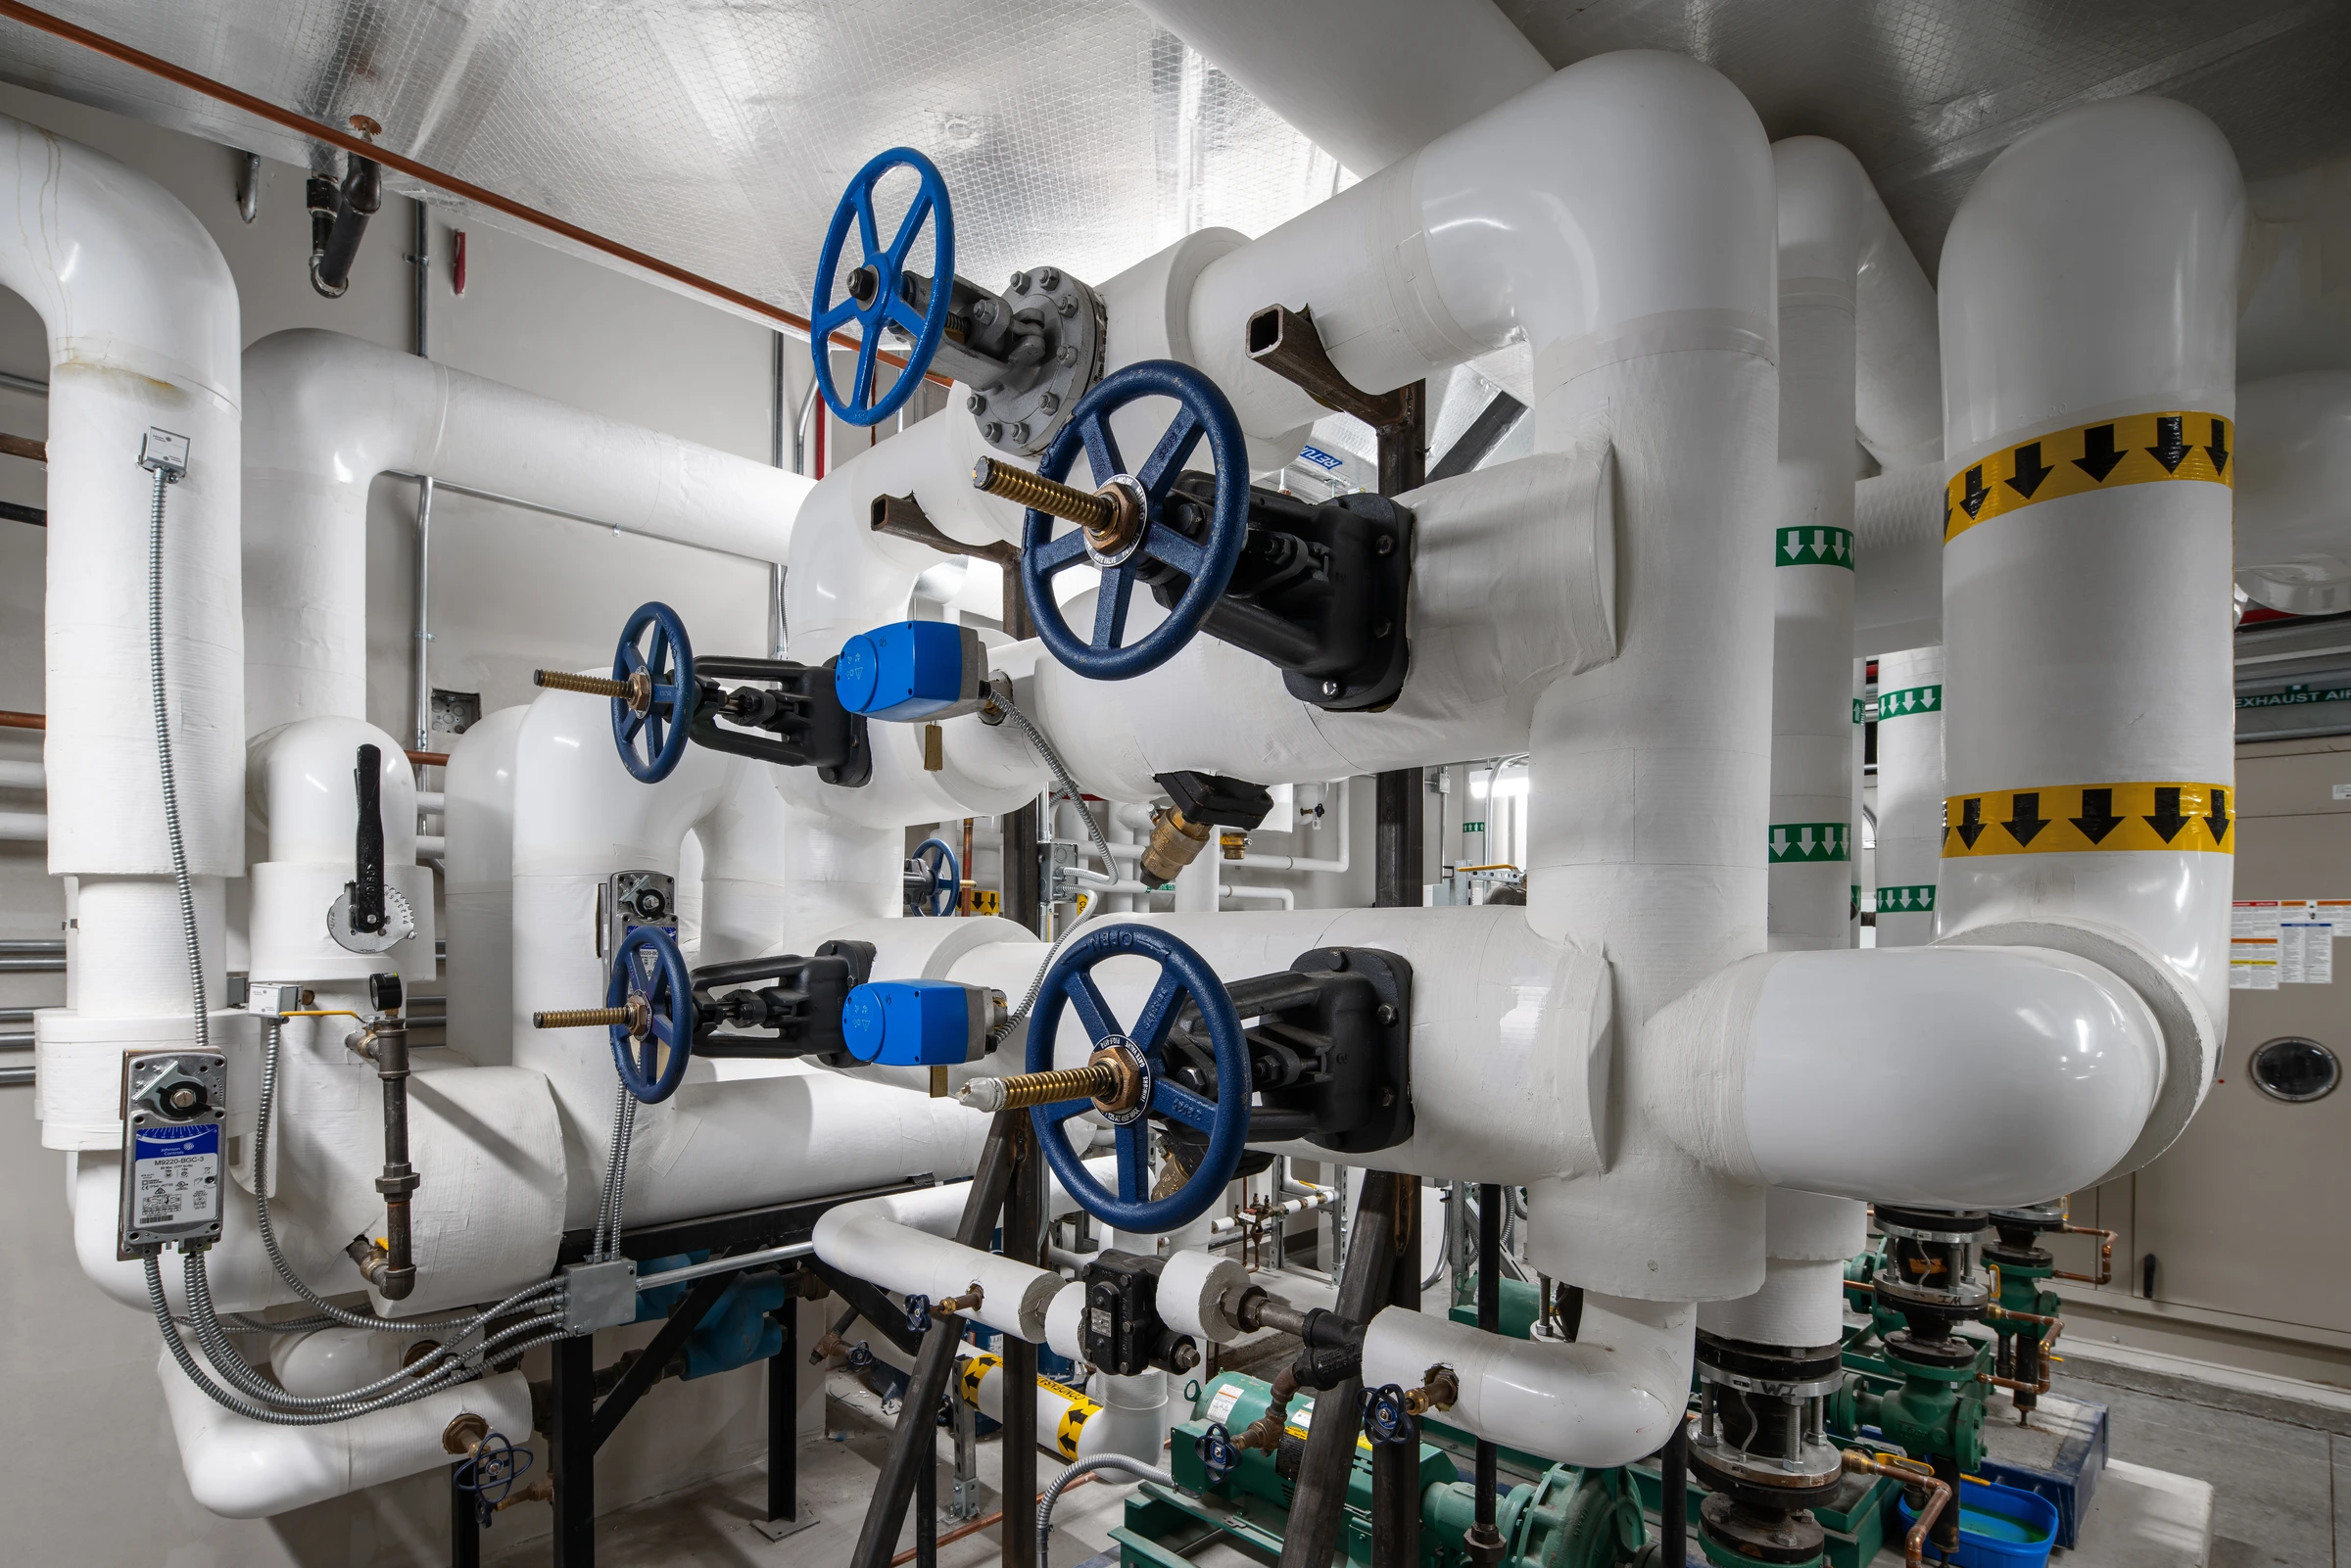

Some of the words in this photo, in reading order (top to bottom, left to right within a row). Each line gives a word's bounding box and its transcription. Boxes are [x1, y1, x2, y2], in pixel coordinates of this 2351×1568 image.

[1134, 486, 1145, 521] NIBCO
[2234, 691, 2321, 708] EXHAUST
[1089, 929, 1134, 953] OPEN
[1125, 1040, 1137, 1055] VALVE
[1134, 1053, 1145, 1069] GATE
[1129, 1107, 1140, 1118] MAX
[154, 1157, 205, 1165] M9220-BGC-3
[1759, 1381, 1799, 1397] WI
